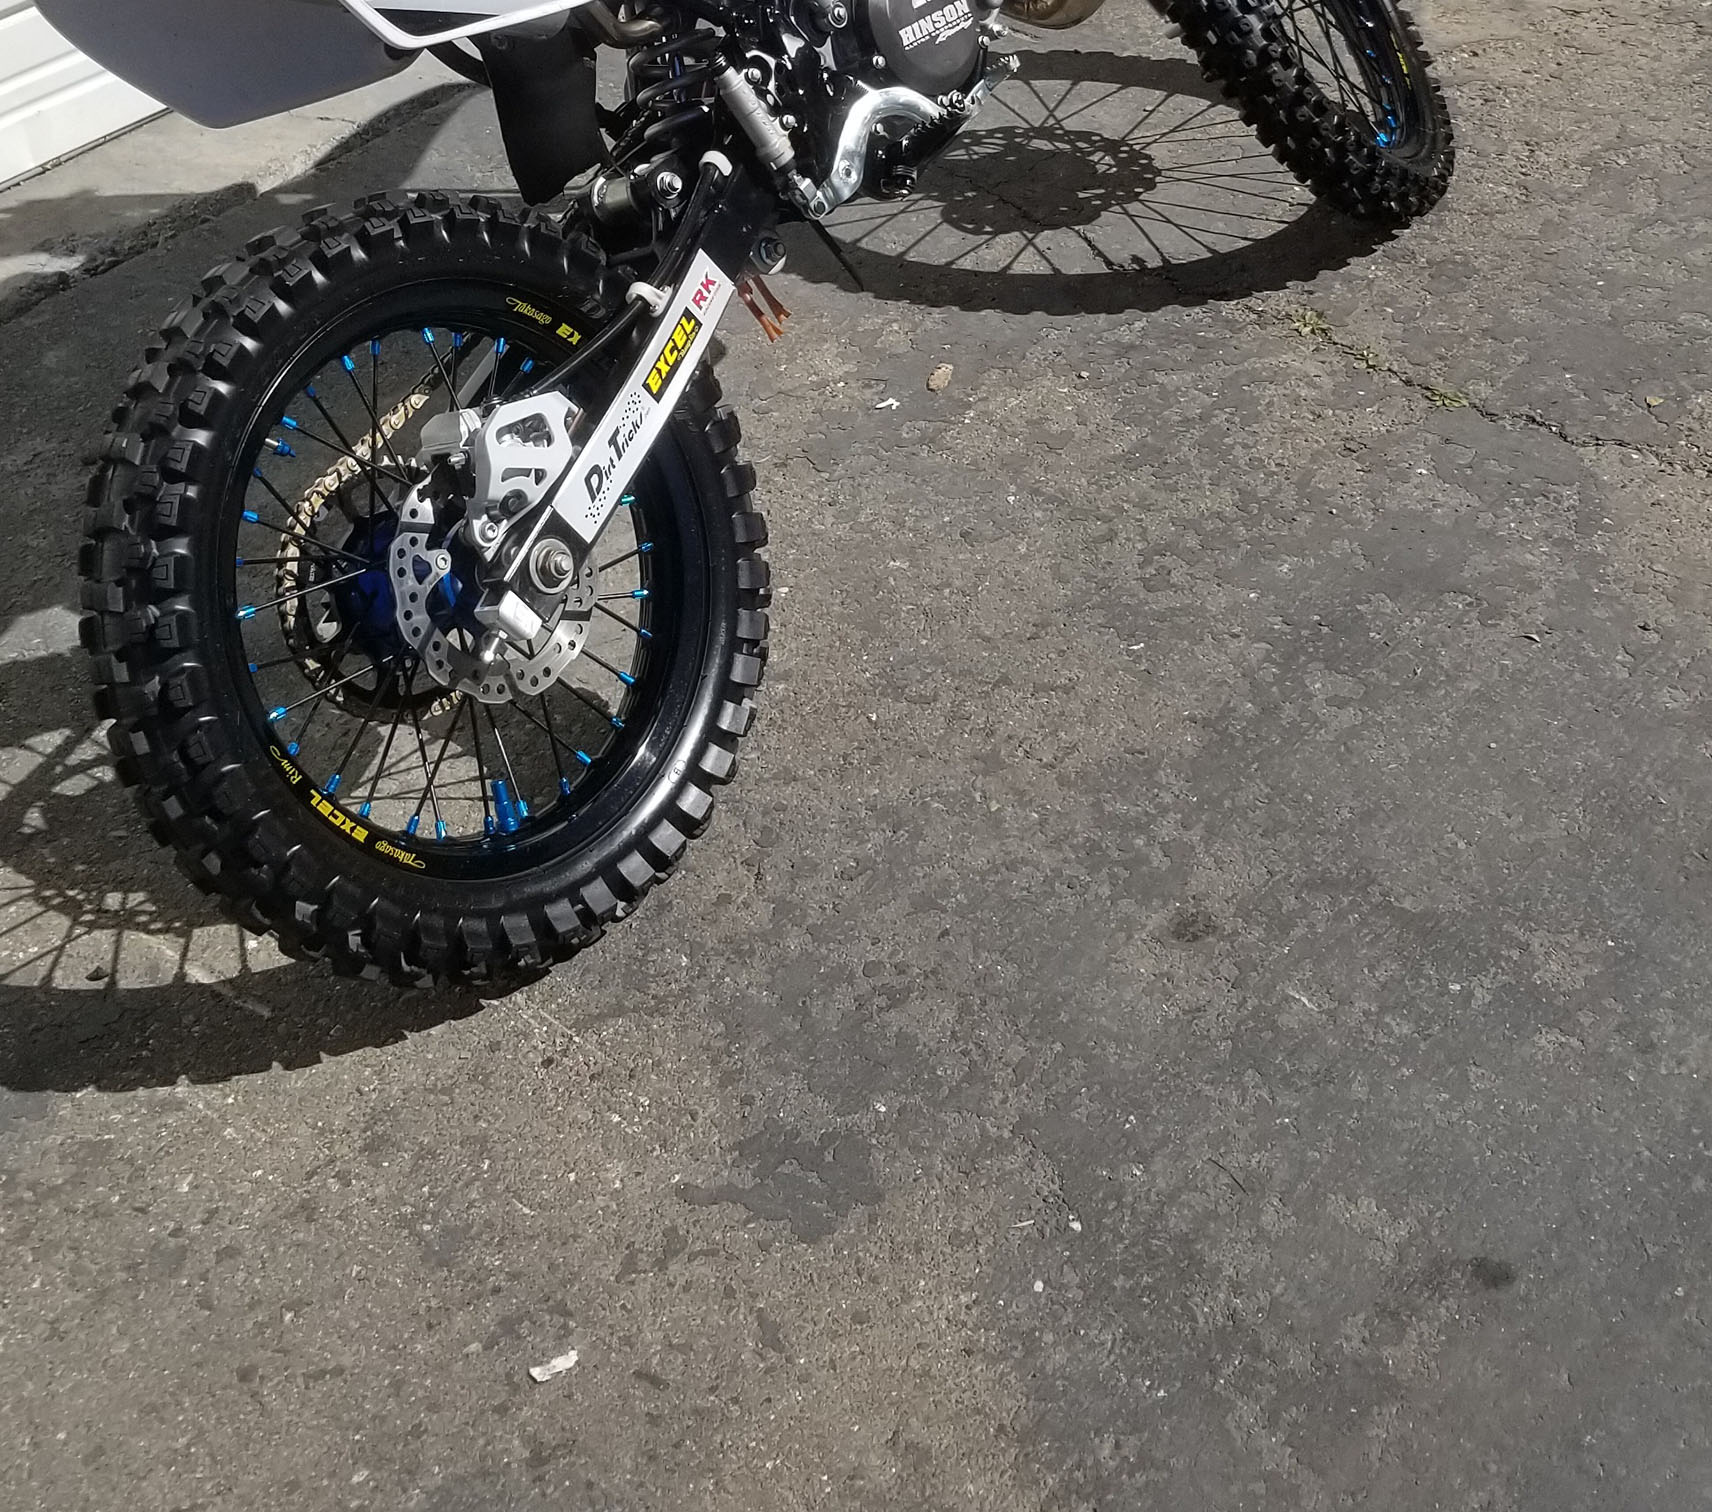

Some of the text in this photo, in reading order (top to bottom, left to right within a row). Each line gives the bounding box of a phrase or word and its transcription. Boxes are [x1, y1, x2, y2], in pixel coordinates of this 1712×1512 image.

[692, 270, 717, 311] RK
[646, 316, 696, 395] EXCEL
[309, 788, 369, 844] EXCEL
